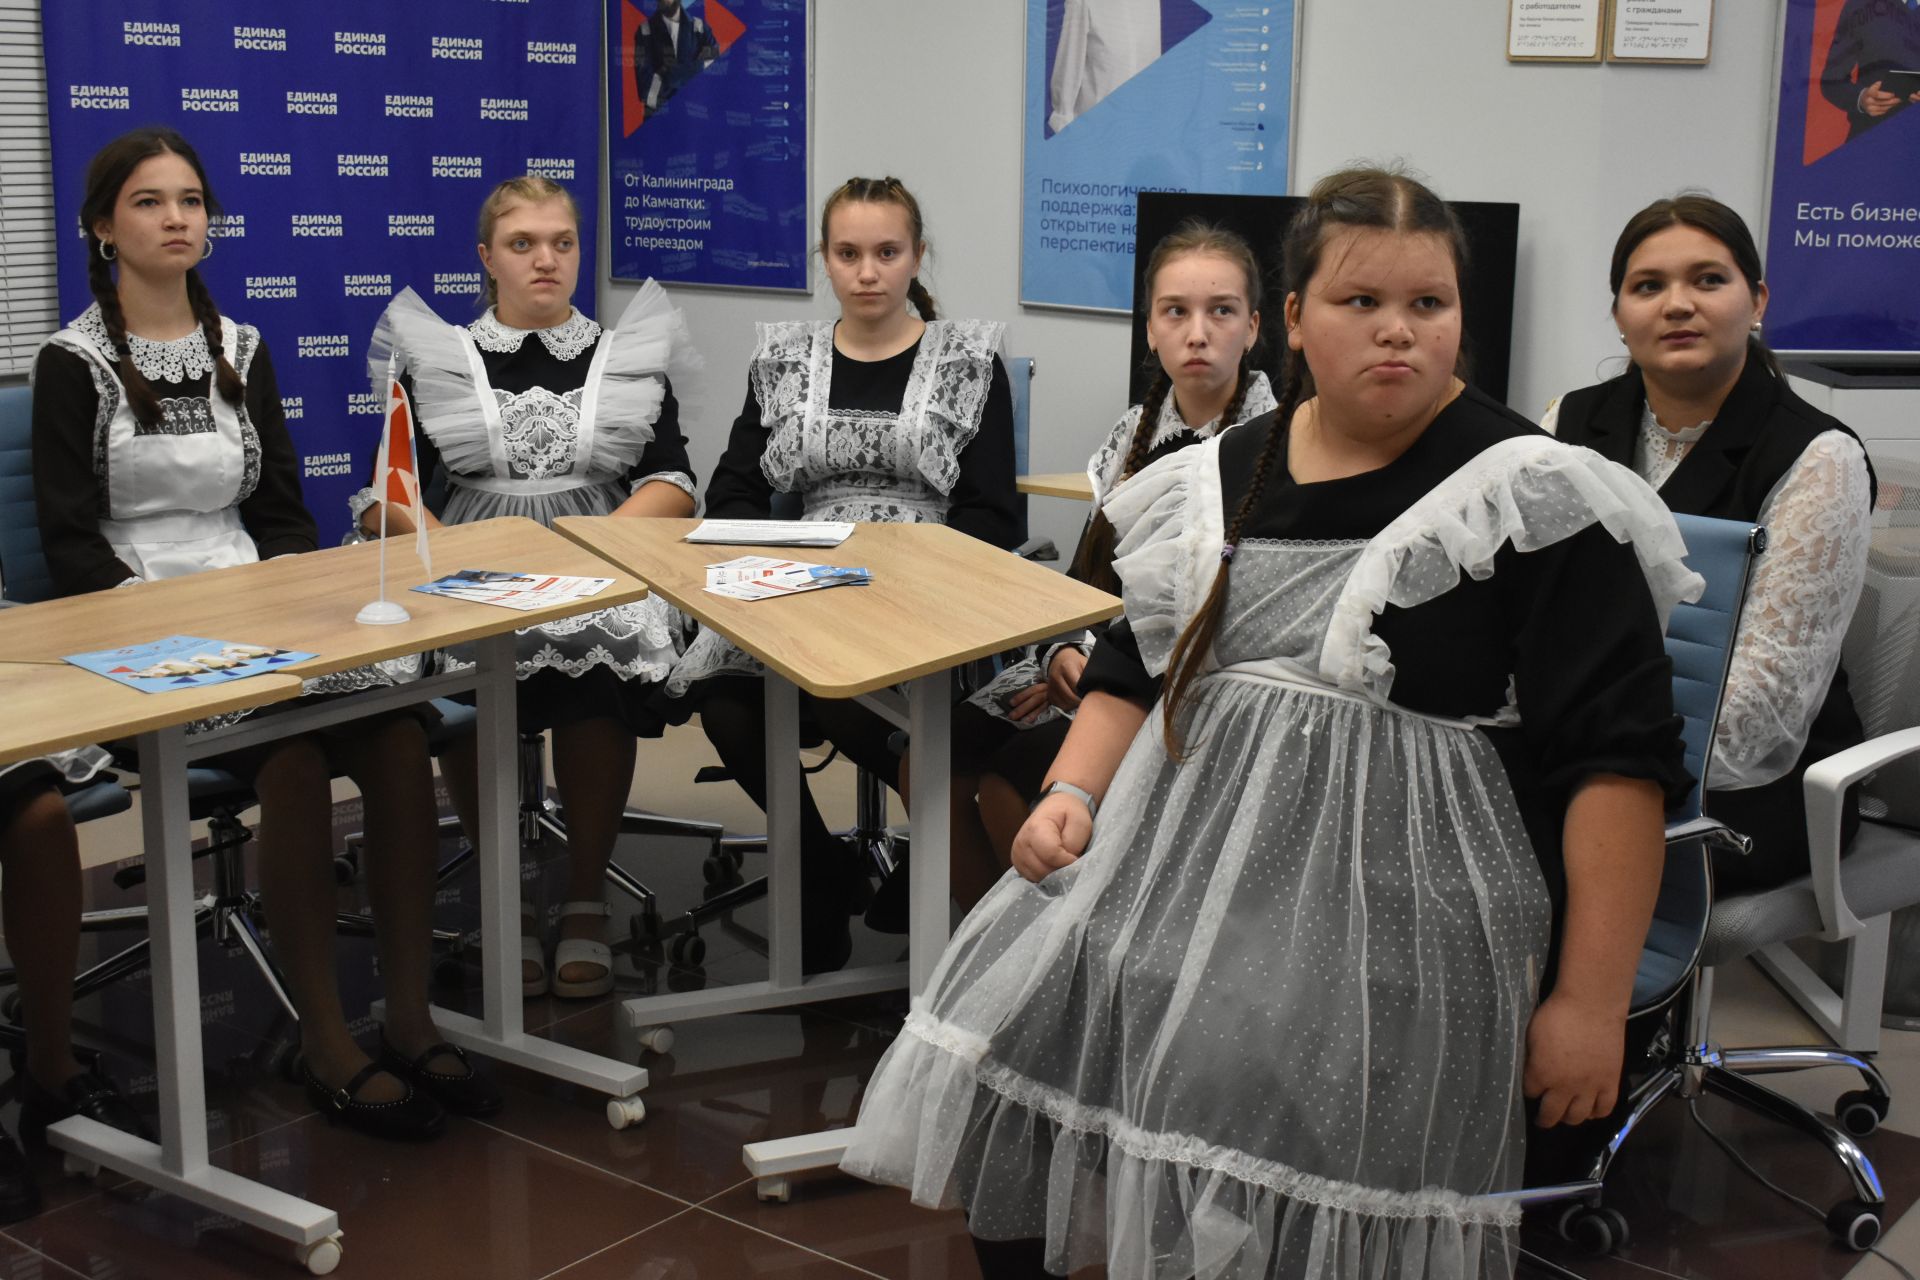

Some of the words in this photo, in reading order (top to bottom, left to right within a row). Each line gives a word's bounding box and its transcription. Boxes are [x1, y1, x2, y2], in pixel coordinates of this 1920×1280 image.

[124, 22, 180, 33] ЕДИНАЯ
[234, 27, 285, 38] ЕДИНАЯ
[125, 34, 180, 46] РОССИЯ
[335, 32, 385, 43] ЕДИНАЯ
[432, 37, 482, 48] ЕДИНАЯ
[235, 39, 286, 51] РОССИЯ
[335, 44, 386, 55] РОССИЯ
[528, 42, 576, 52] ЕДИНАЯ
[432, 48, 482, 60] РОССИЯ
[528, 53, 576, 64] РОССИЯ
[71, 86, 128, 96] ЕДИНАЯ
[182, 89, 238, 99] ЕДИНАЯ
[287, 92, 337, 102] ЕДИНАЯ
[385, 95, 433, 105] ЕДИНАЯ
[71, 98, 129, 109] РОССИЯ
[183, 101, 238, 111] РОССИЯ
[287, 103, 337, 114] РОССИЯ
[481, 99, 528, 109] ЕДИНАЯ
[386, 107, 433, 117] РОССИЯ
[481, 110, 528, 120] РОССИЯ
[240, 153, 290, 163] ЕДИНАЯ
[338, 155, 388, 165] ЕДИНАЯ
[433, 156, 481, 166] ЕДИНАЯ
[527, 159, 574, 168] ЕДИНАЯ
[241, 165, 291, 175] РОССИЯ
[338, 166, 388, 176] РОССИЯ
[433, 168, 481, 178] РОССИЯ
[527, 169, 574, 179] РОССИЯ
[624, 174, 640, 187] От
[642, 174, 734, 192] Калининграда
[624, 196, 640, 208] до
[642, 194, 705, 210] Камчатки:
[1041, 200, 1136, 217] поддержка:
[1797, 202, 1845, 221] Есть
[1851, 202, 1920, 222] бизне
[208, 215, 244, 225] ИНАЯ
[292, 215, 342, 225] ЕДИНАЯ
[389, 215, 434, 225] ЕДИНАЯ
[625, 216, 711, 232] трудоустроим
[208, 226, 245, 237] ССИЯ
[293, 226, 342, 236] РОССИЯ
[389, 226, 434, 236] РОССИЯ
[1040, 218, 1116, 236] открытие
[1794, 229, 1831, 247] Мы
[625, 236, 632, 247] с
[635, 236, 704, 251] переездом
[246, 277, 296, 287] ЕДИНАЯ
[344, 275, 391, 285] ЕДИНАЯ
[434, 273, 480, 283] ЕДИНАЯ
[247, 288, 296, 298] РОССИЯ
[344, 285, 391, 296] РОССИЯ
[434, 284, 480, 294] РОССИЯ
[298, 335, 348, 346] ЕДИНАЯ
[299, 347, 349, 357] РОССИЯ
[281, 397, 303, 407] НАЯ
[348, 404, 386, 415] РОСС
[305, 453, 350, 466] ЕДИНАЯ
[305, 464, 351, 477] РОССИЯ
